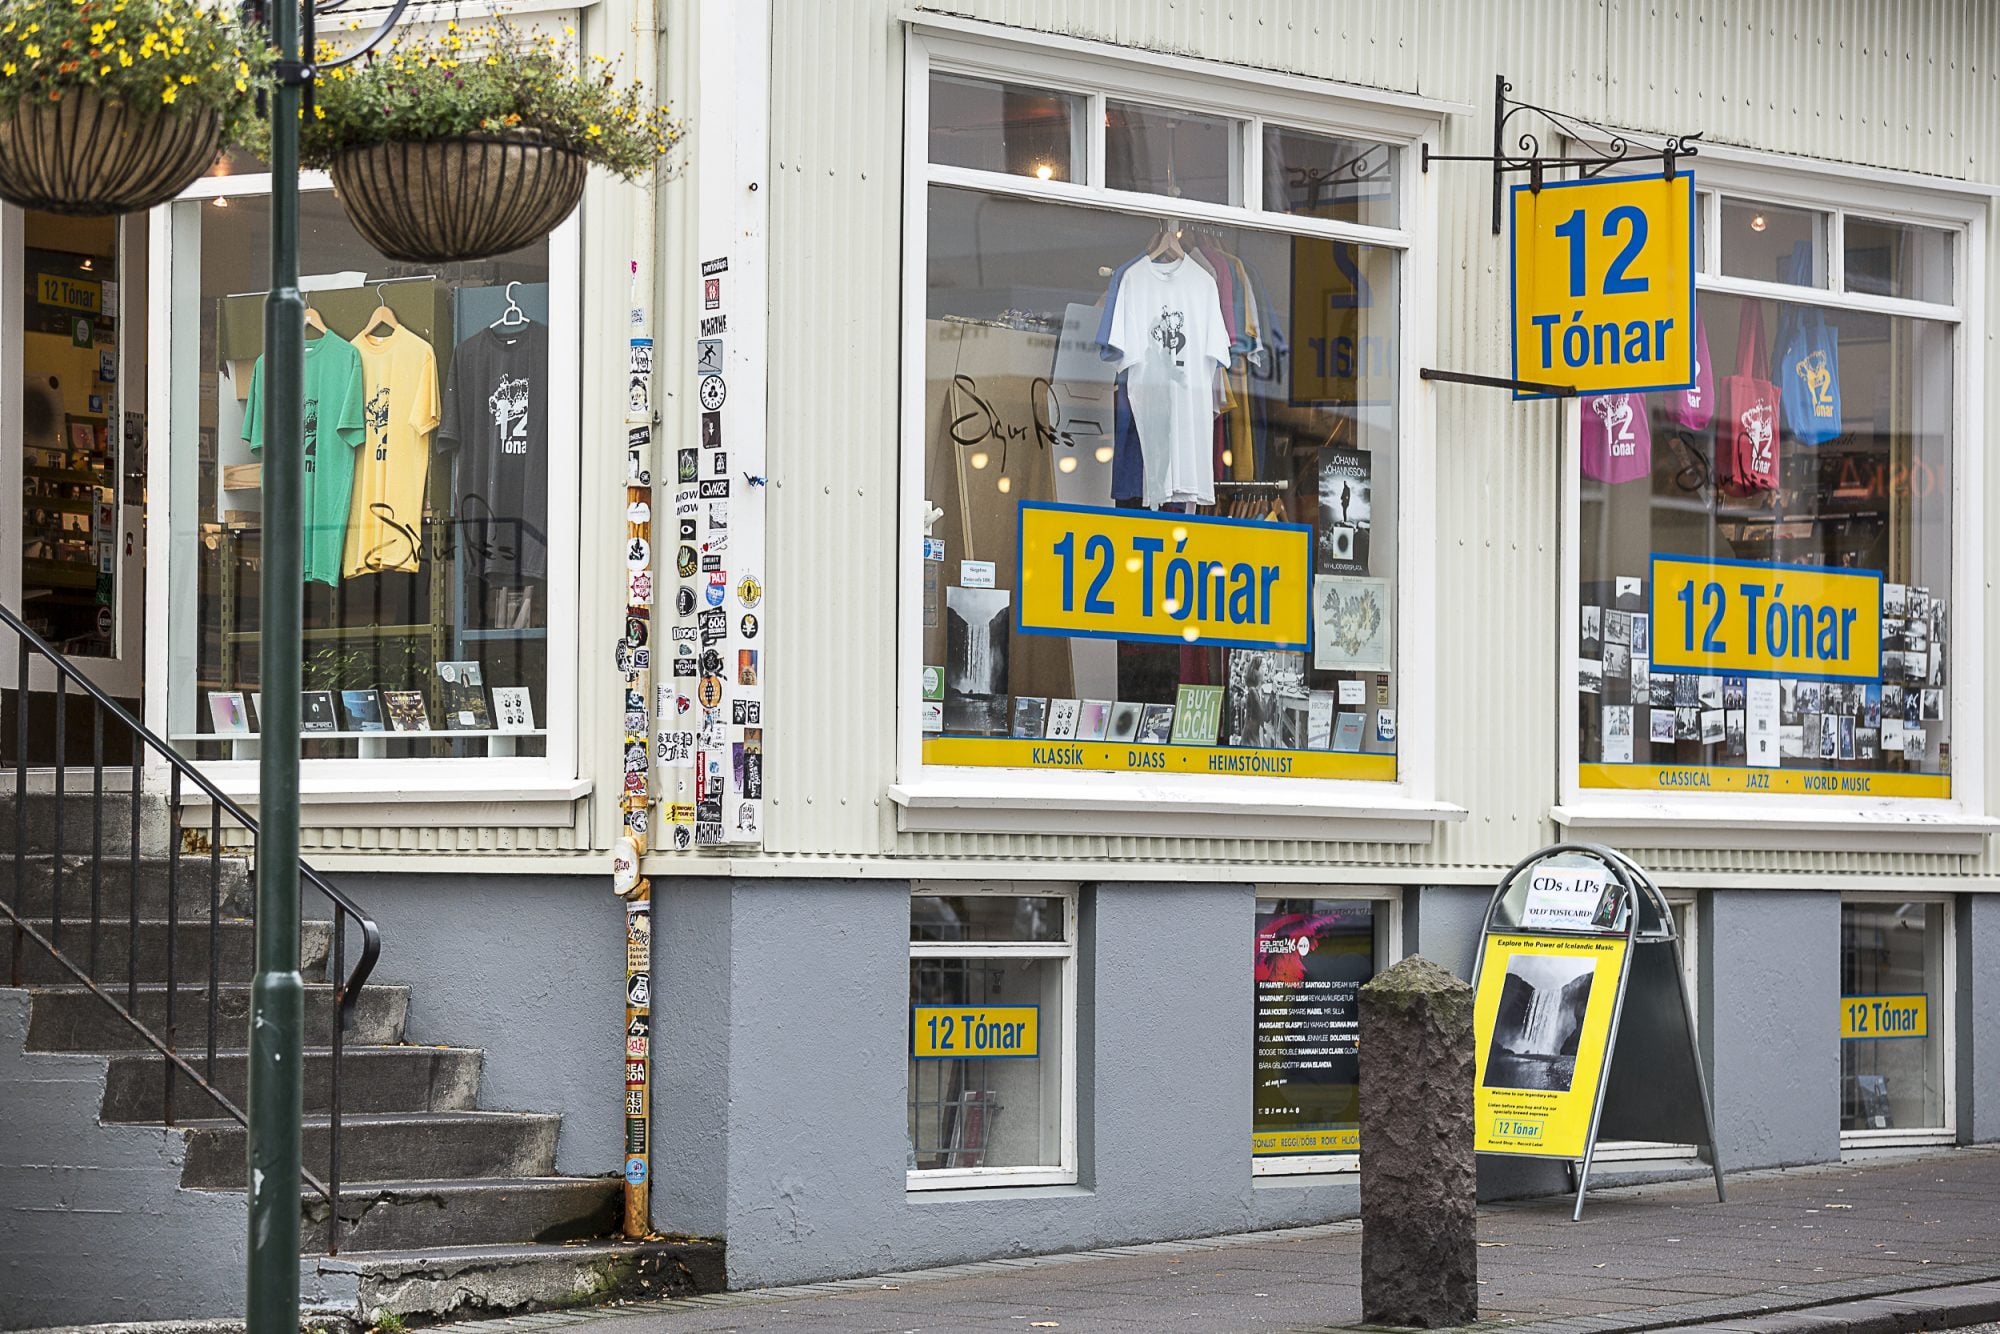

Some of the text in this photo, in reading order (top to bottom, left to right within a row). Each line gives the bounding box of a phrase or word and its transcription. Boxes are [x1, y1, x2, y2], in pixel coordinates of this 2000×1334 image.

[1555, 205, 1649, 297] 12
[44, 279, 95, 307] 12 Tónar
[1532, 310, 1674, 368] Tónar
[1332, 455, 1359, 466] JÓHANN
[1054, 532, 1279, 625] 12 Tónar
[1678, 580, 1856, 661] 12 Tónar
[1187, 689, 1214, 709] BUY
[1176, 699, 1215, 739] LOCAL
[1380, 715, 1392, 725] tax
[1380, 725, 1394, 735] free
[1033, 744, 1293, 773] KLASSÍK DJASS HEIMSTÓNLIST
[1659, 771, 1871, 791] CLASSICAL JAZZ WORLD MUSIC
[1533, 877, 1562, 892] CDs
[1574, 879, 1599, 894] LPs
[1849, 1001, 1918, 1032] 12 Tónar
[928, 1014, 1025, 1049] 12 Tónar
[1499, 1122, 1538, 1135] 12 Tónar
